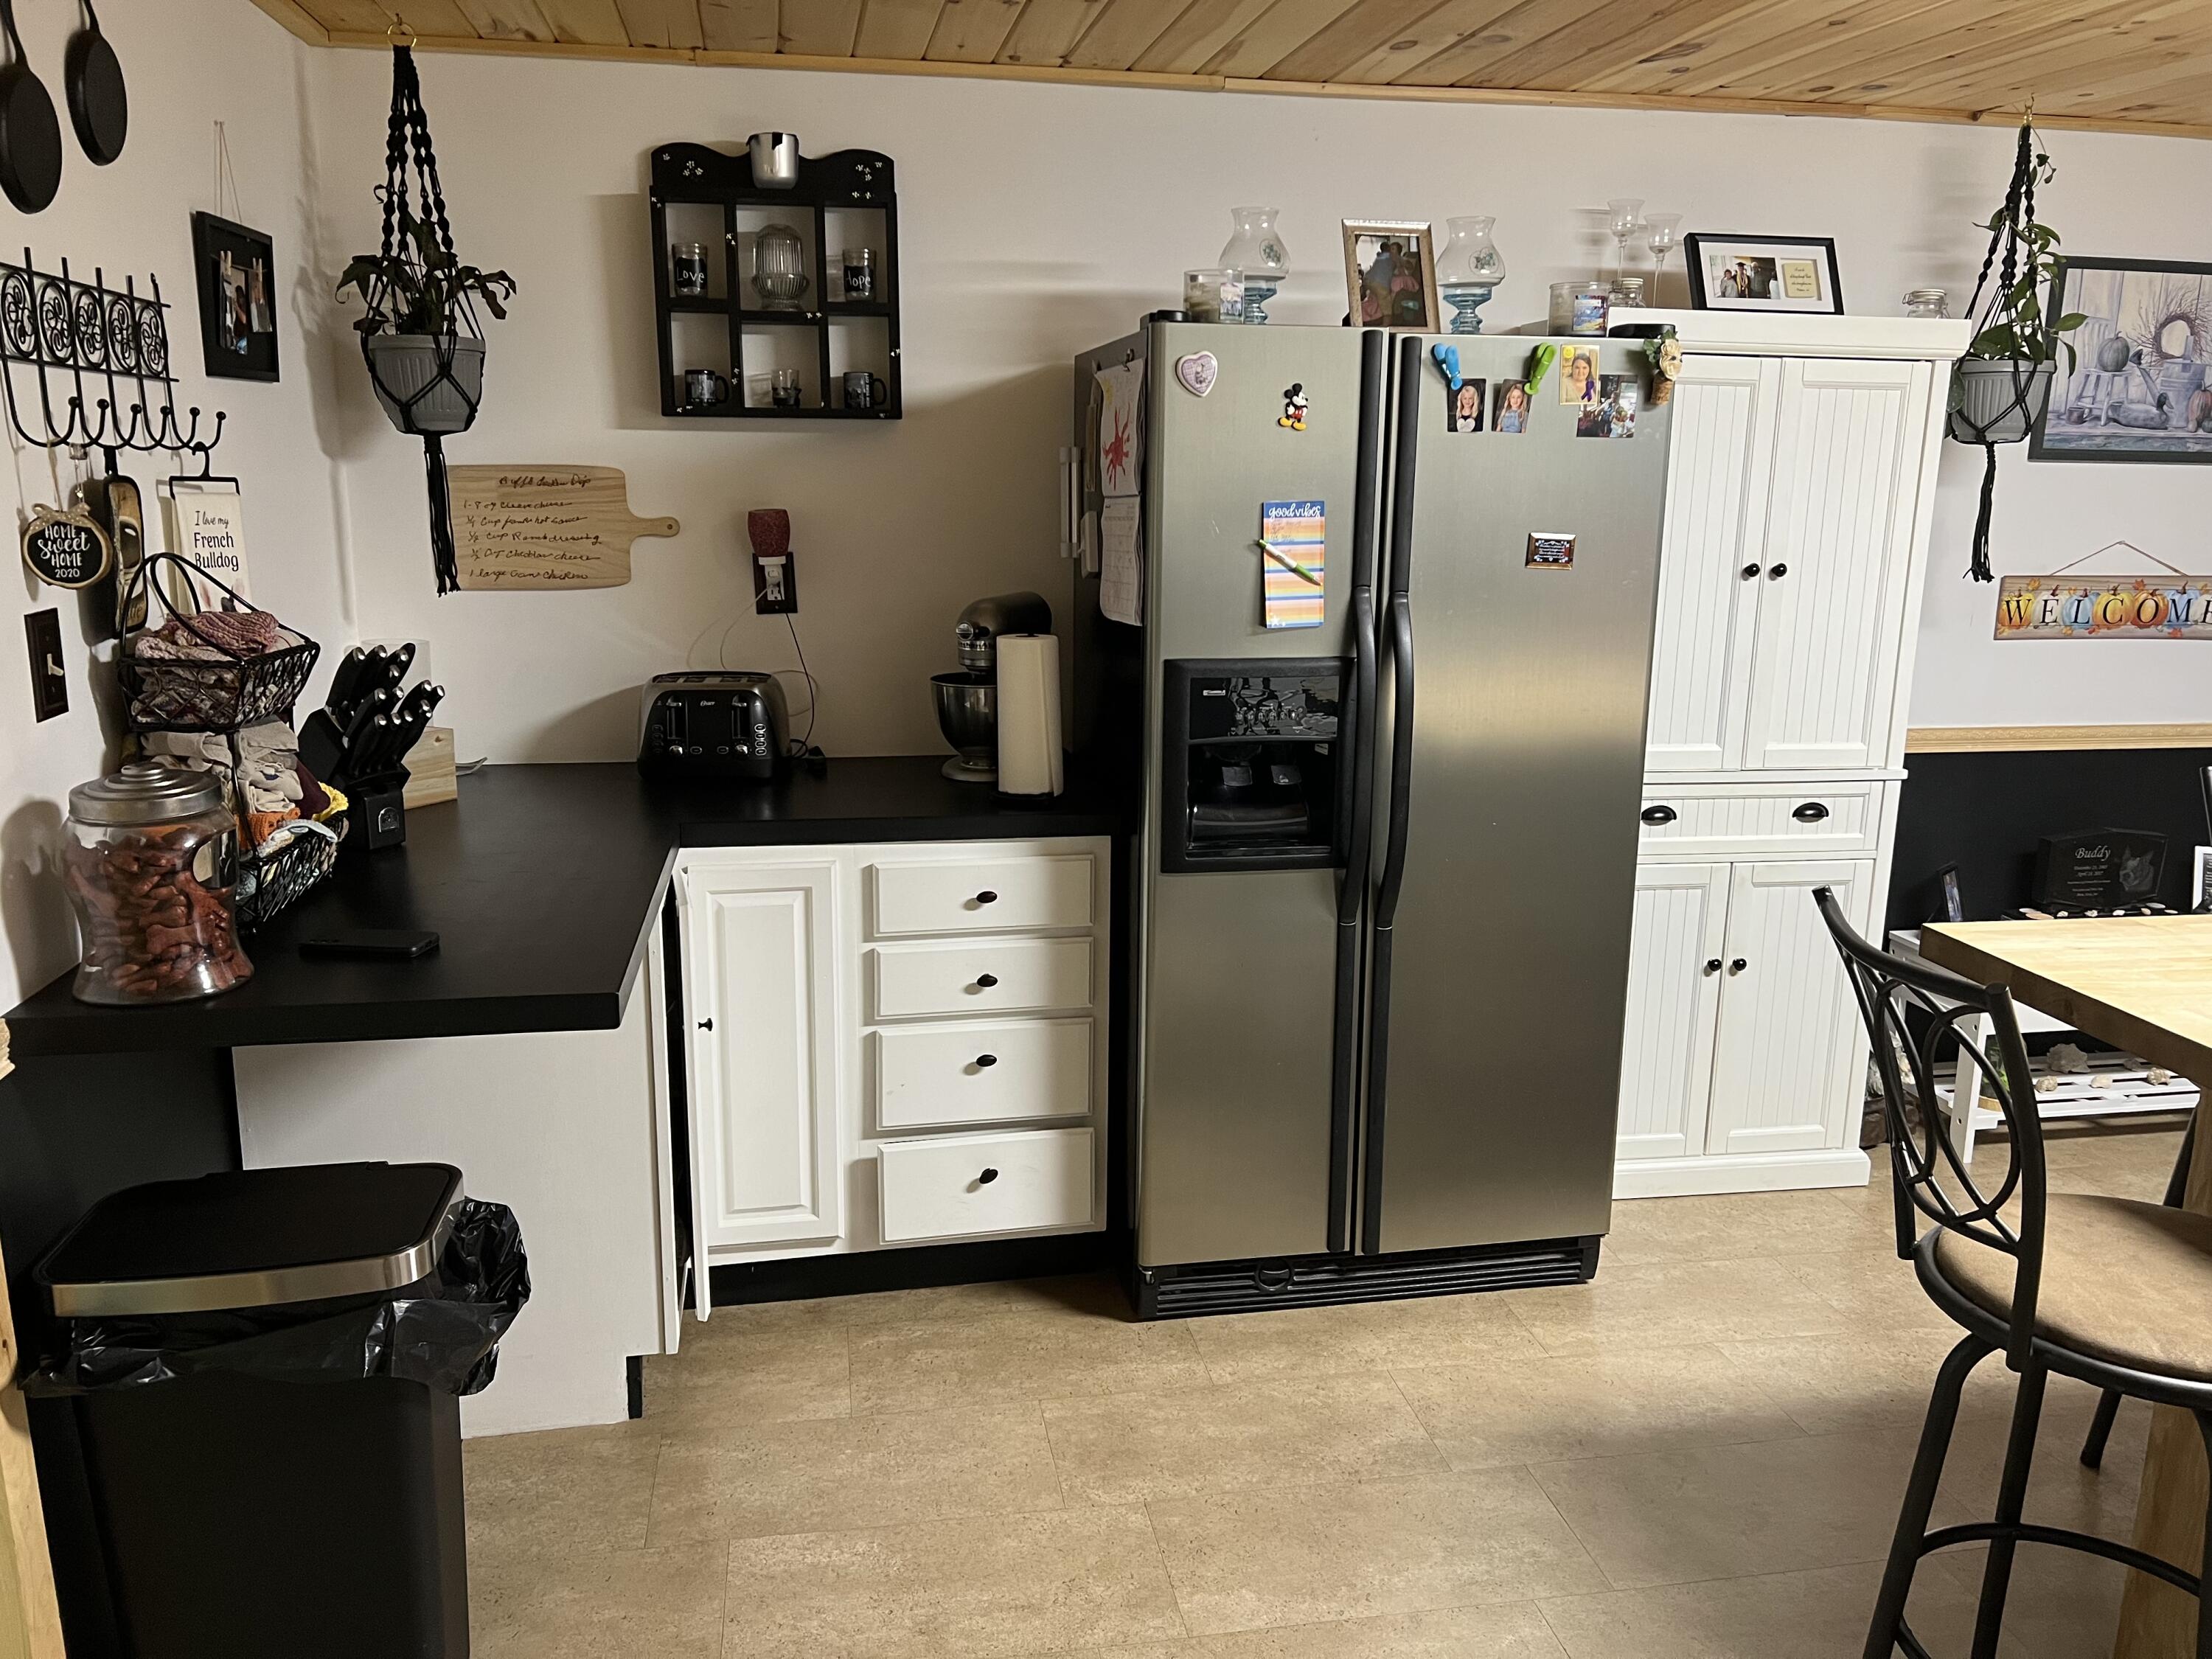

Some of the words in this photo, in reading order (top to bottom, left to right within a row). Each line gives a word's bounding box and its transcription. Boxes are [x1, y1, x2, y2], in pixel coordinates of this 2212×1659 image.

[677, 266, 706, 283] Love
[195, 510, 201, 526] I
[202, 510, 216, 525] love
[218, 518, 229, 529] my
[535, 516, 551, 524] hot
[1268, 502, 1295, 522] good
[1295, 502, 1321, 519] vibes
[44, 525, 77, 540] HOME
[194, 531, 234, 549] French
[37, 532, 91, 560] sweet
[51, 552, 83, 568] HOME
[195, 552, 240, 572] Bulldog
[55, 568, 80, 578] 2020
[2075, 845, 2111, 862] Buddy
